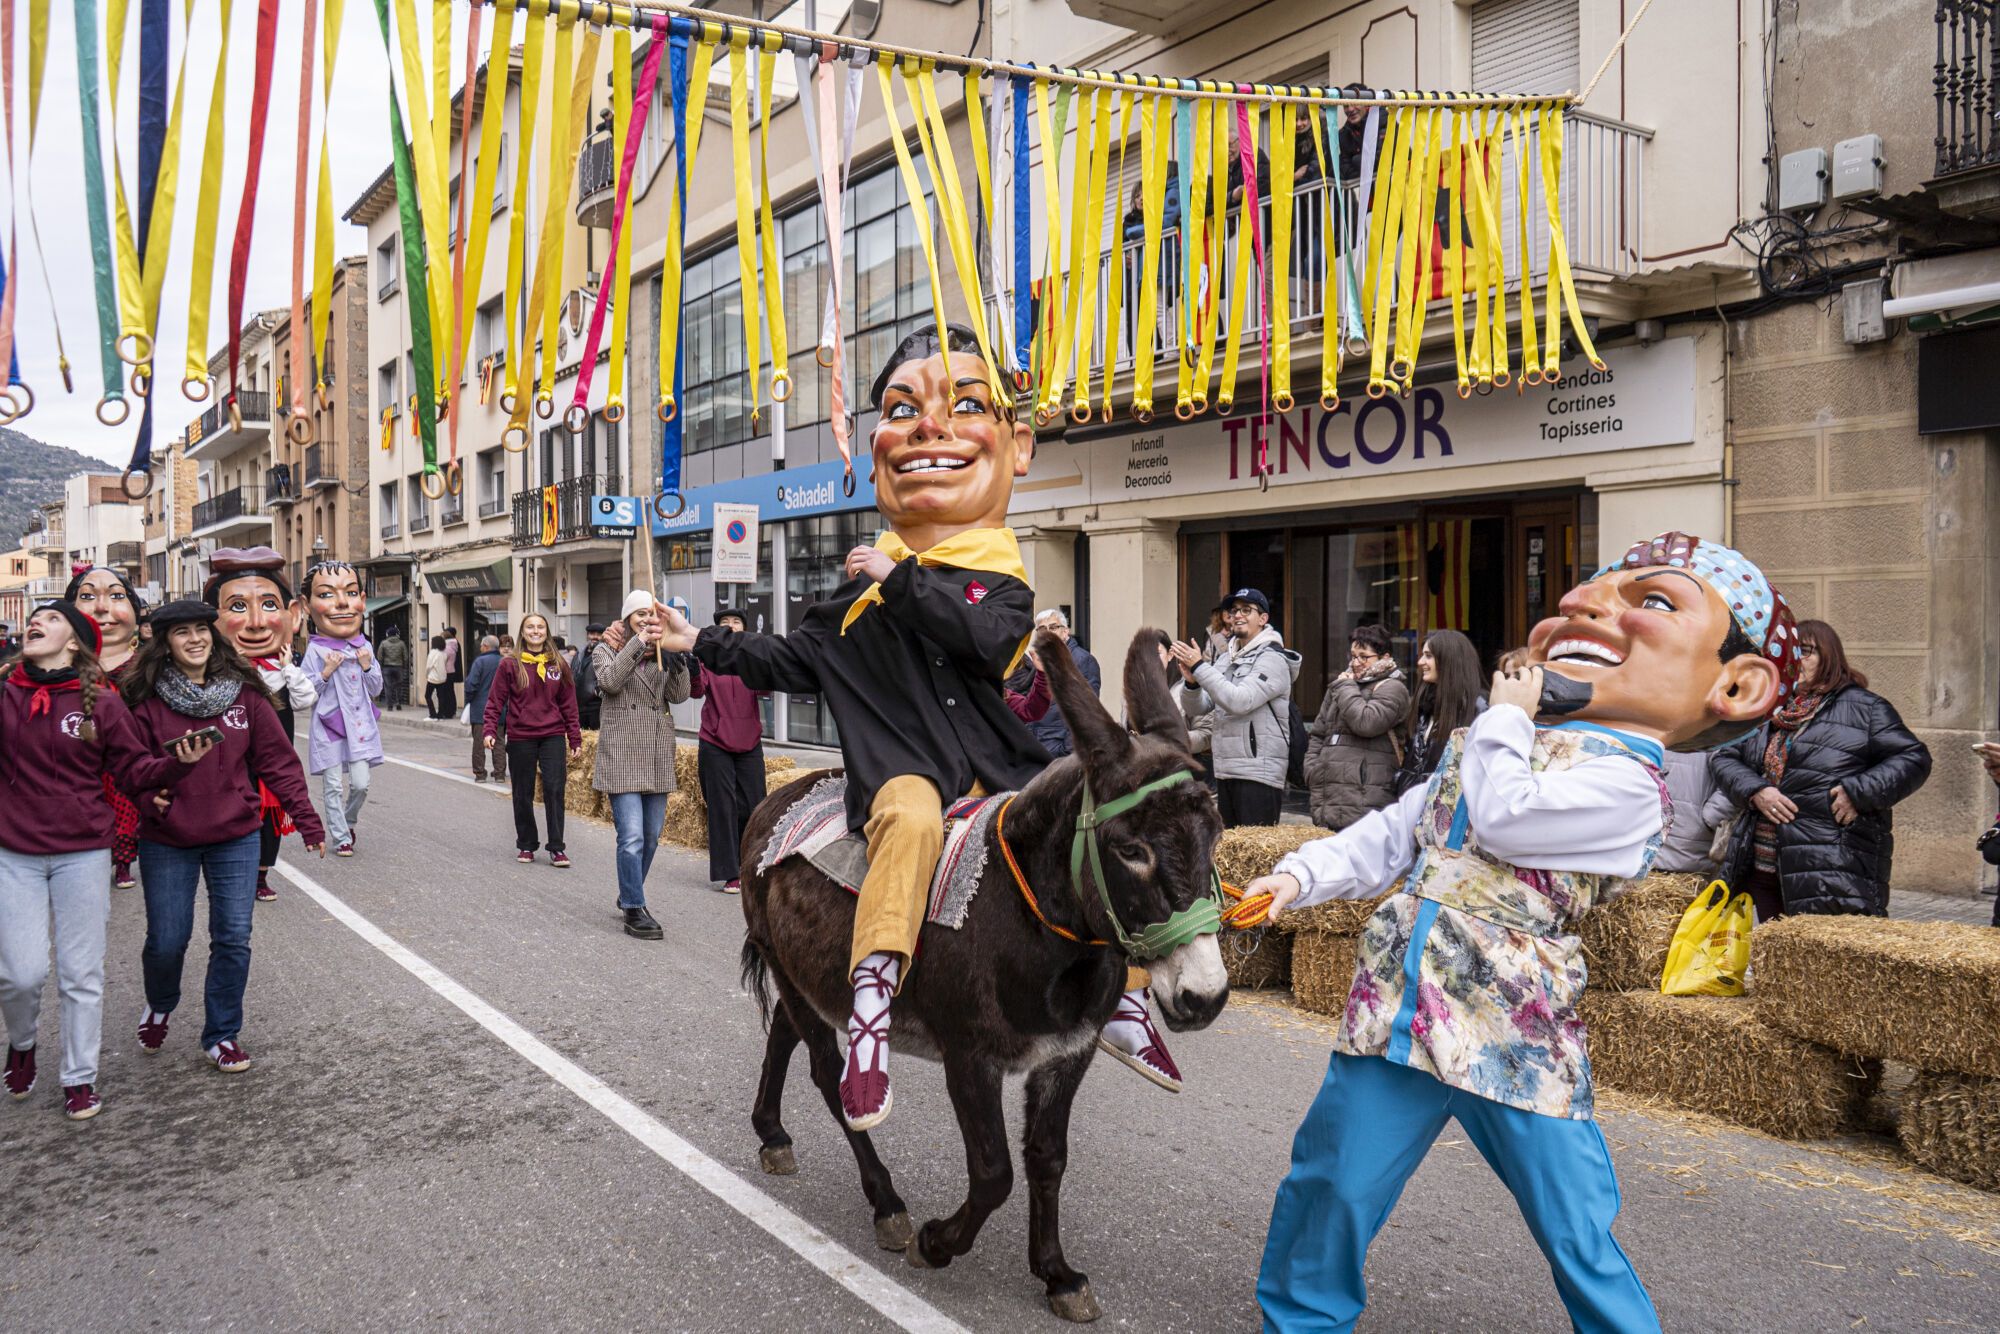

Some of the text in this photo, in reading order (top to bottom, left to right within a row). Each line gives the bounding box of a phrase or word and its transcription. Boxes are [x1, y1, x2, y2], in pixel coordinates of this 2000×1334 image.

[1549, 368, 1614, 391] Tendais
[1547, 394, 1616, 415] Cortines
[1222, 387, 1454, 480] TENCOR
[1539, 415, 1623, 443] Tapisseria
[1131, 435, 1164, 452] Infantil
[1127, 453, 1168, 471] Merceria
[1125, 470, 1172, 489] Decoració
[785, 480, 835, 510] Sabadell
[616, 501, 634, 525] S
